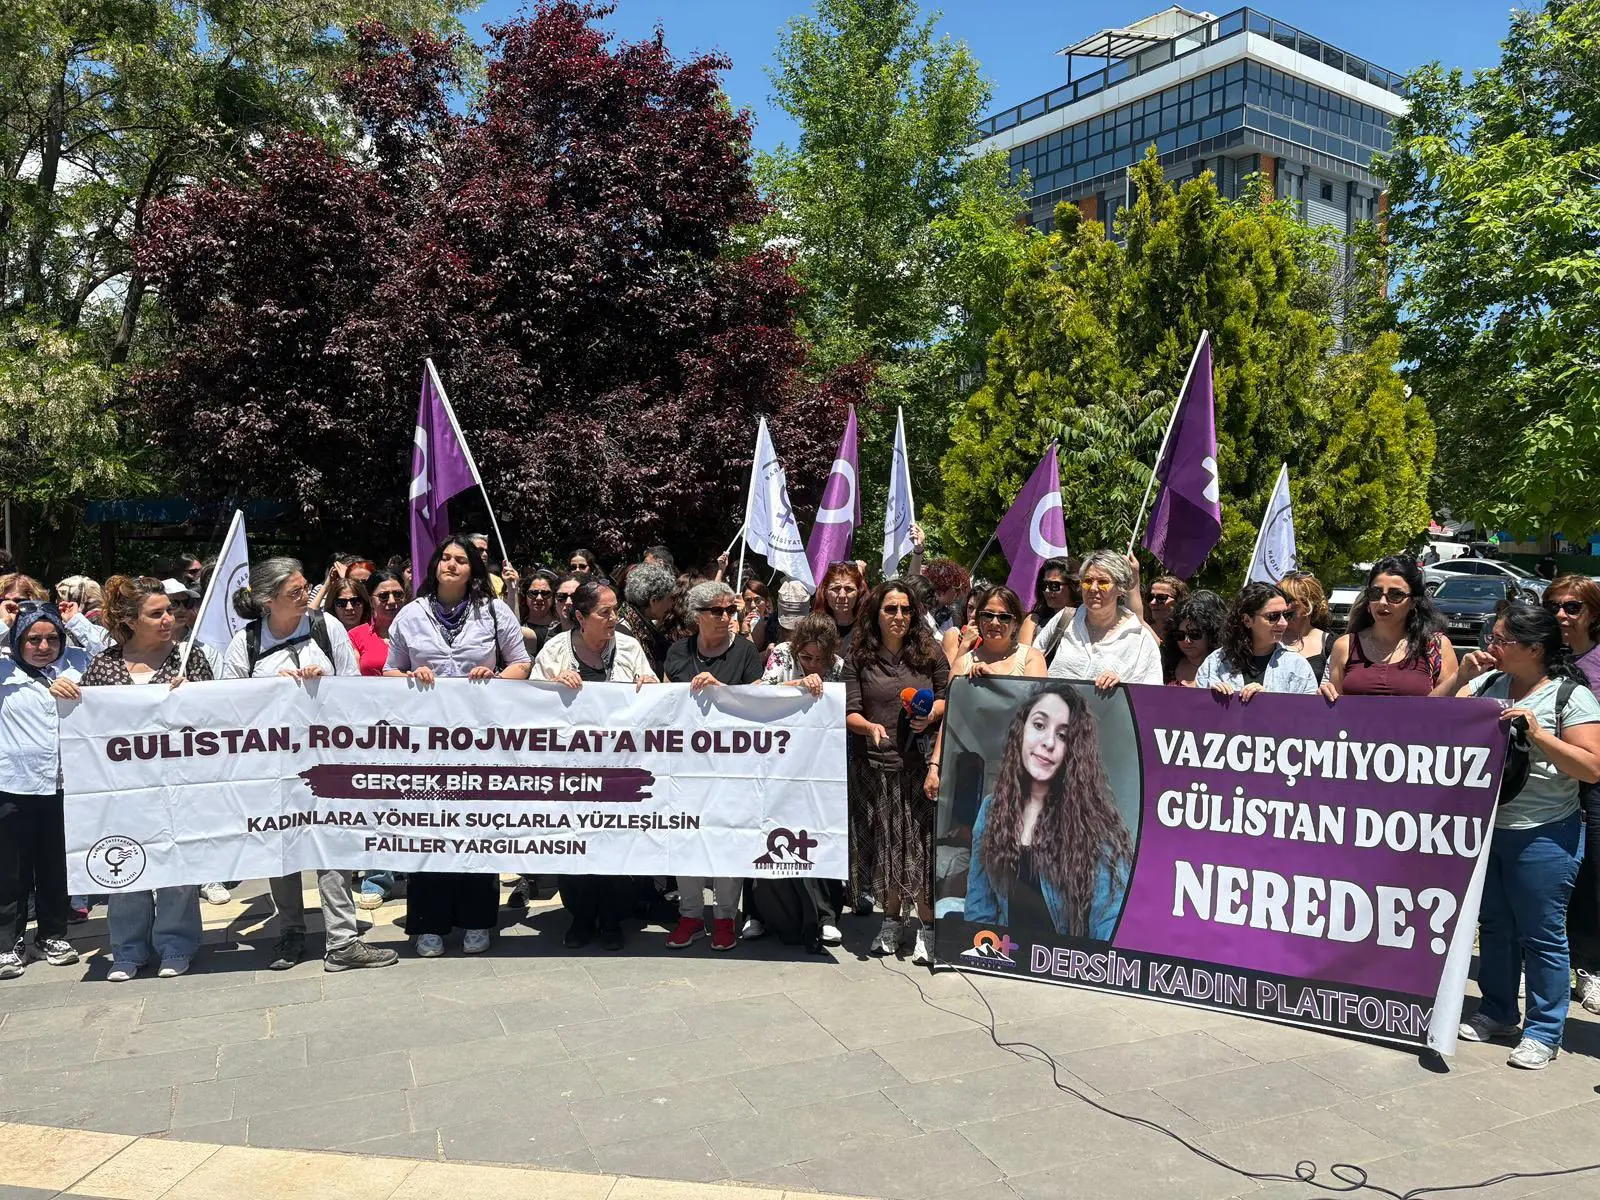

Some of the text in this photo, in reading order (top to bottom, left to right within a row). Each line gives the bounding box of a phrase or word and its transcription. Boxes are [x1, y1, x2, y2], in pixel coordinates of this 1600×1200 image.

[107, 726, 300, 762] GULÎSTAN,
[309, 719, 420, 754] ROJÎN,
[644, 730, 684, 753] NE
[691, 730, 791, 754] OLDU?
[1153, 728, 1492, 788] VAZGEÇMİYORUZ
[351, 771, 603, 795] GERÇEK BİR BARIŞ İÇİN
[248, 808, 700, 832] KADINLARA YÖNELİK SUÇLARLA YÜZLEŞİLSİN
[364, 834, 586, 855] FAİLLER YARGILANSIN
[1157, 783, 1482, 859] GÜLİSTAN DOKU
[1172, 860, 1458, 955] NEREDE?
[1030, 943, 1140, 989] DERSİM
[1148, 961, 1247, 1008] KADIN
